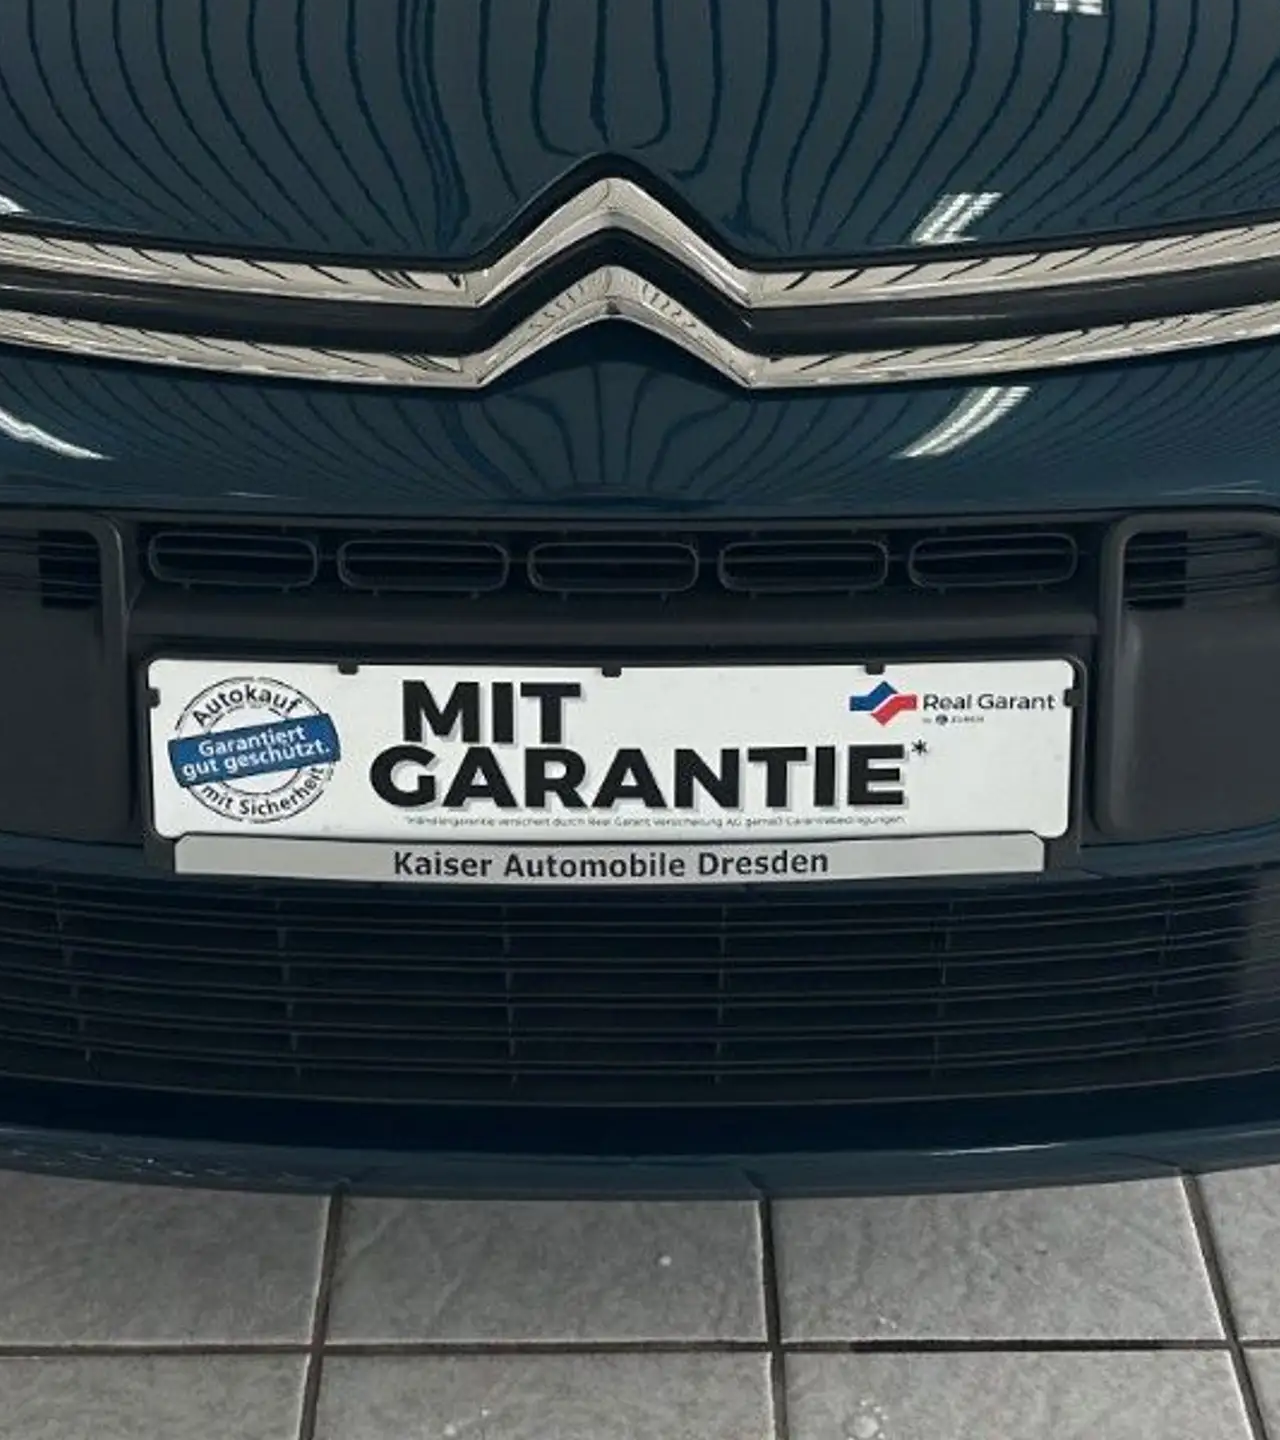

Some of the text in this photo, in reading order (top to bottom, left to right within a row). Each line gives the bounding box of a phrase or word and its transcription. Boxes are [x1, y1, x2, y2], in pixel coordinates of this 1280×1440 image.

[192, 684, 303, 727] Autokauf
[402, 679, 582, 744] MIT
[923, 693, 1056, 710] Real Garant
[198, 724, 307, 757] Garantiert
[182, 757, 221, 781] gut
[201, 762, 334, 816] mit Sicherheit
[394, 850, 829, 878] Kaiser Automobile Dresden
